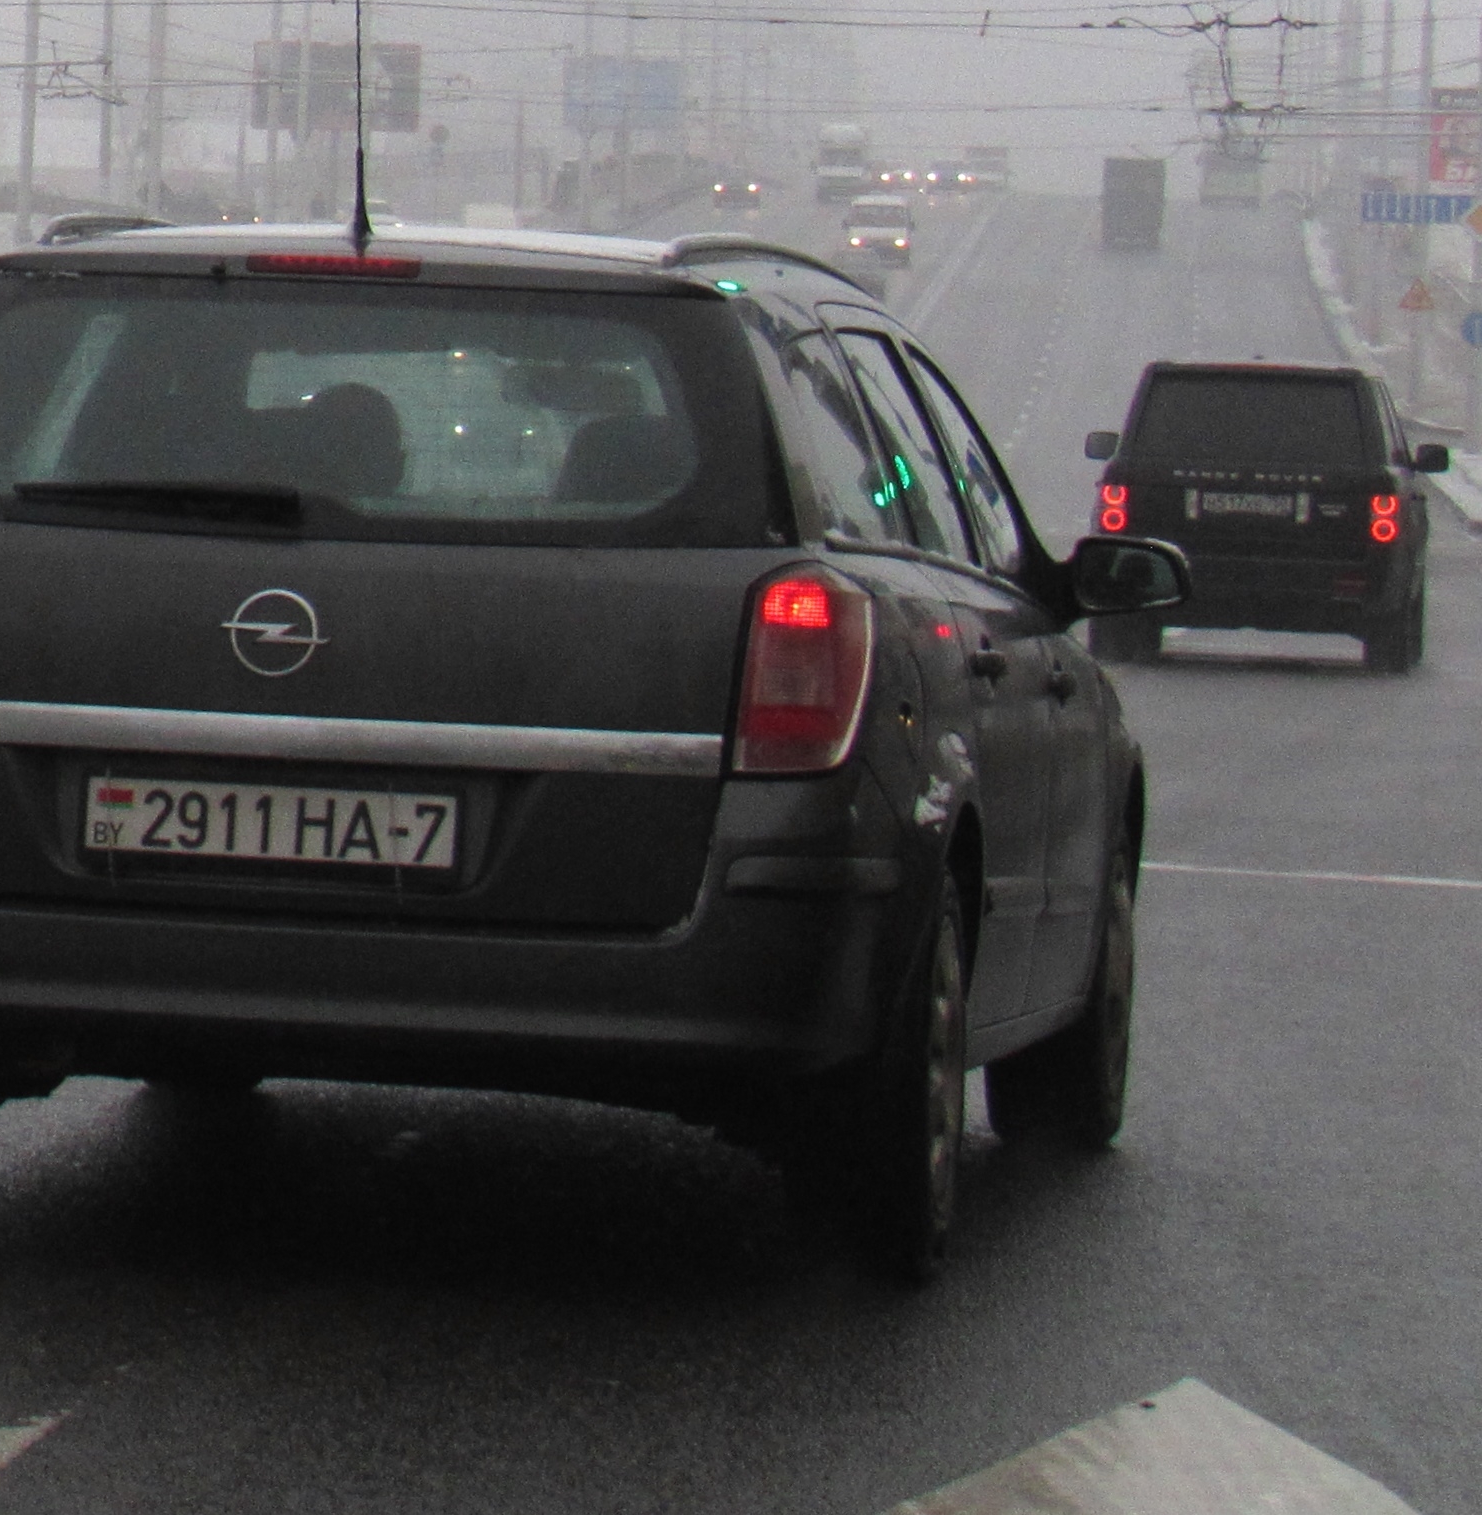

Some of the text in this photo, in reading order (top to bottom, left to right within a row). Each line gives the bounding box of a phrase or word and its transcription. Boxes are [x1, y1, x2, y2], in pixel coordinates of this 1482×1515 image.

[93, 820, 124, 844] BY
[140, 787, 448, 863] 2911 HA-7
